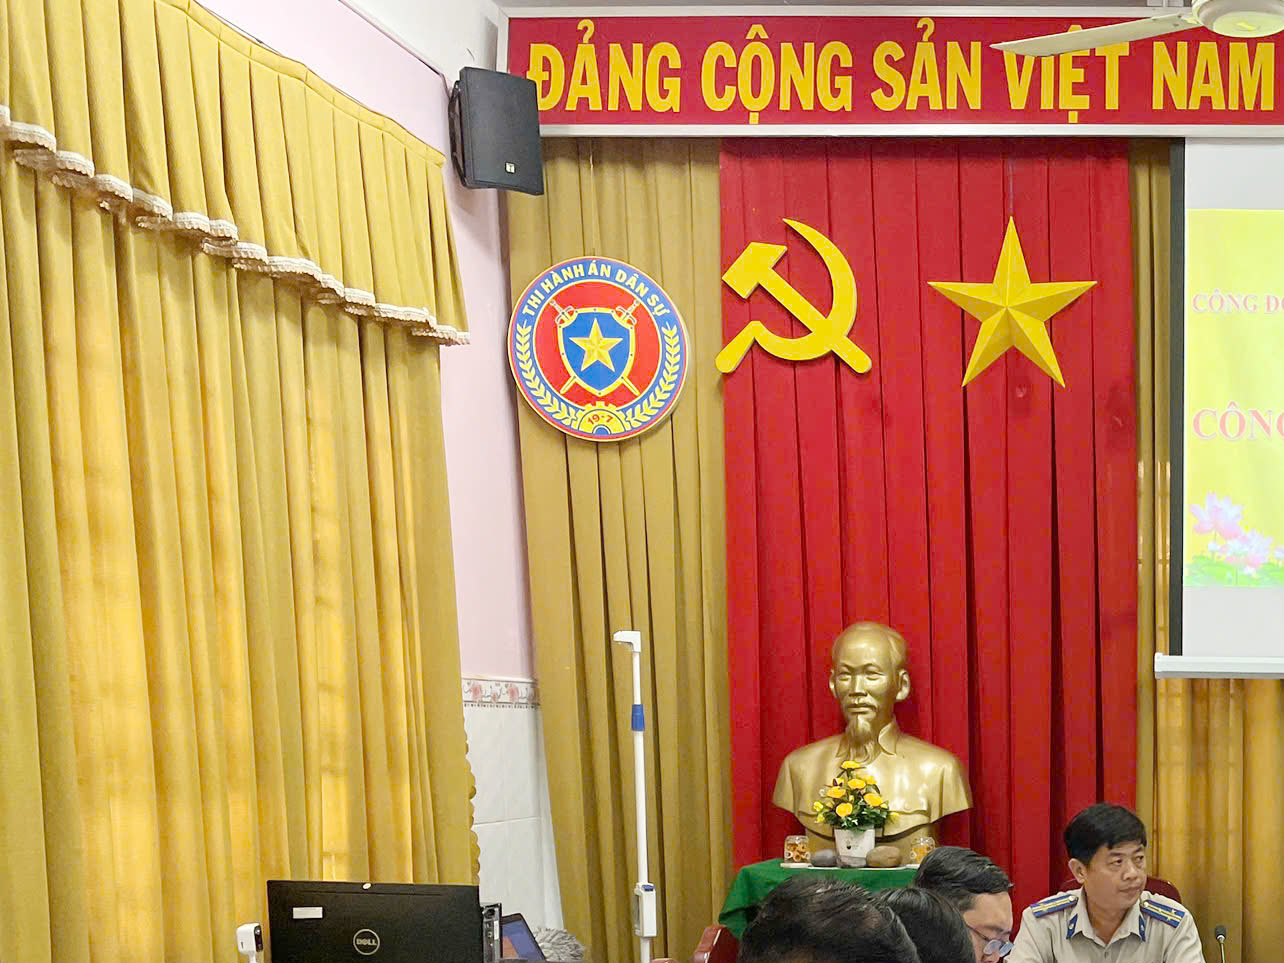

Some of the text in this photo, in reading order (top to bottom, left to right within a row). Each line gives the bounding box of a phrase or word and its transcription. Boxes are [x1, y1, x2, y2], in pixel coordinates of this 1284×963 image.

[527, 20, 681, 113] ĐẢNG
[701, 25, 852, 124] CỘNG
[870, 18, 982, 111] SẢN
[1152, 43, 1274, 111] NAM
[522, 260, 670, 317] THI HÀNH ÁN DÂN SỰ
[1191, 289, 1258, 315] CÔNG
